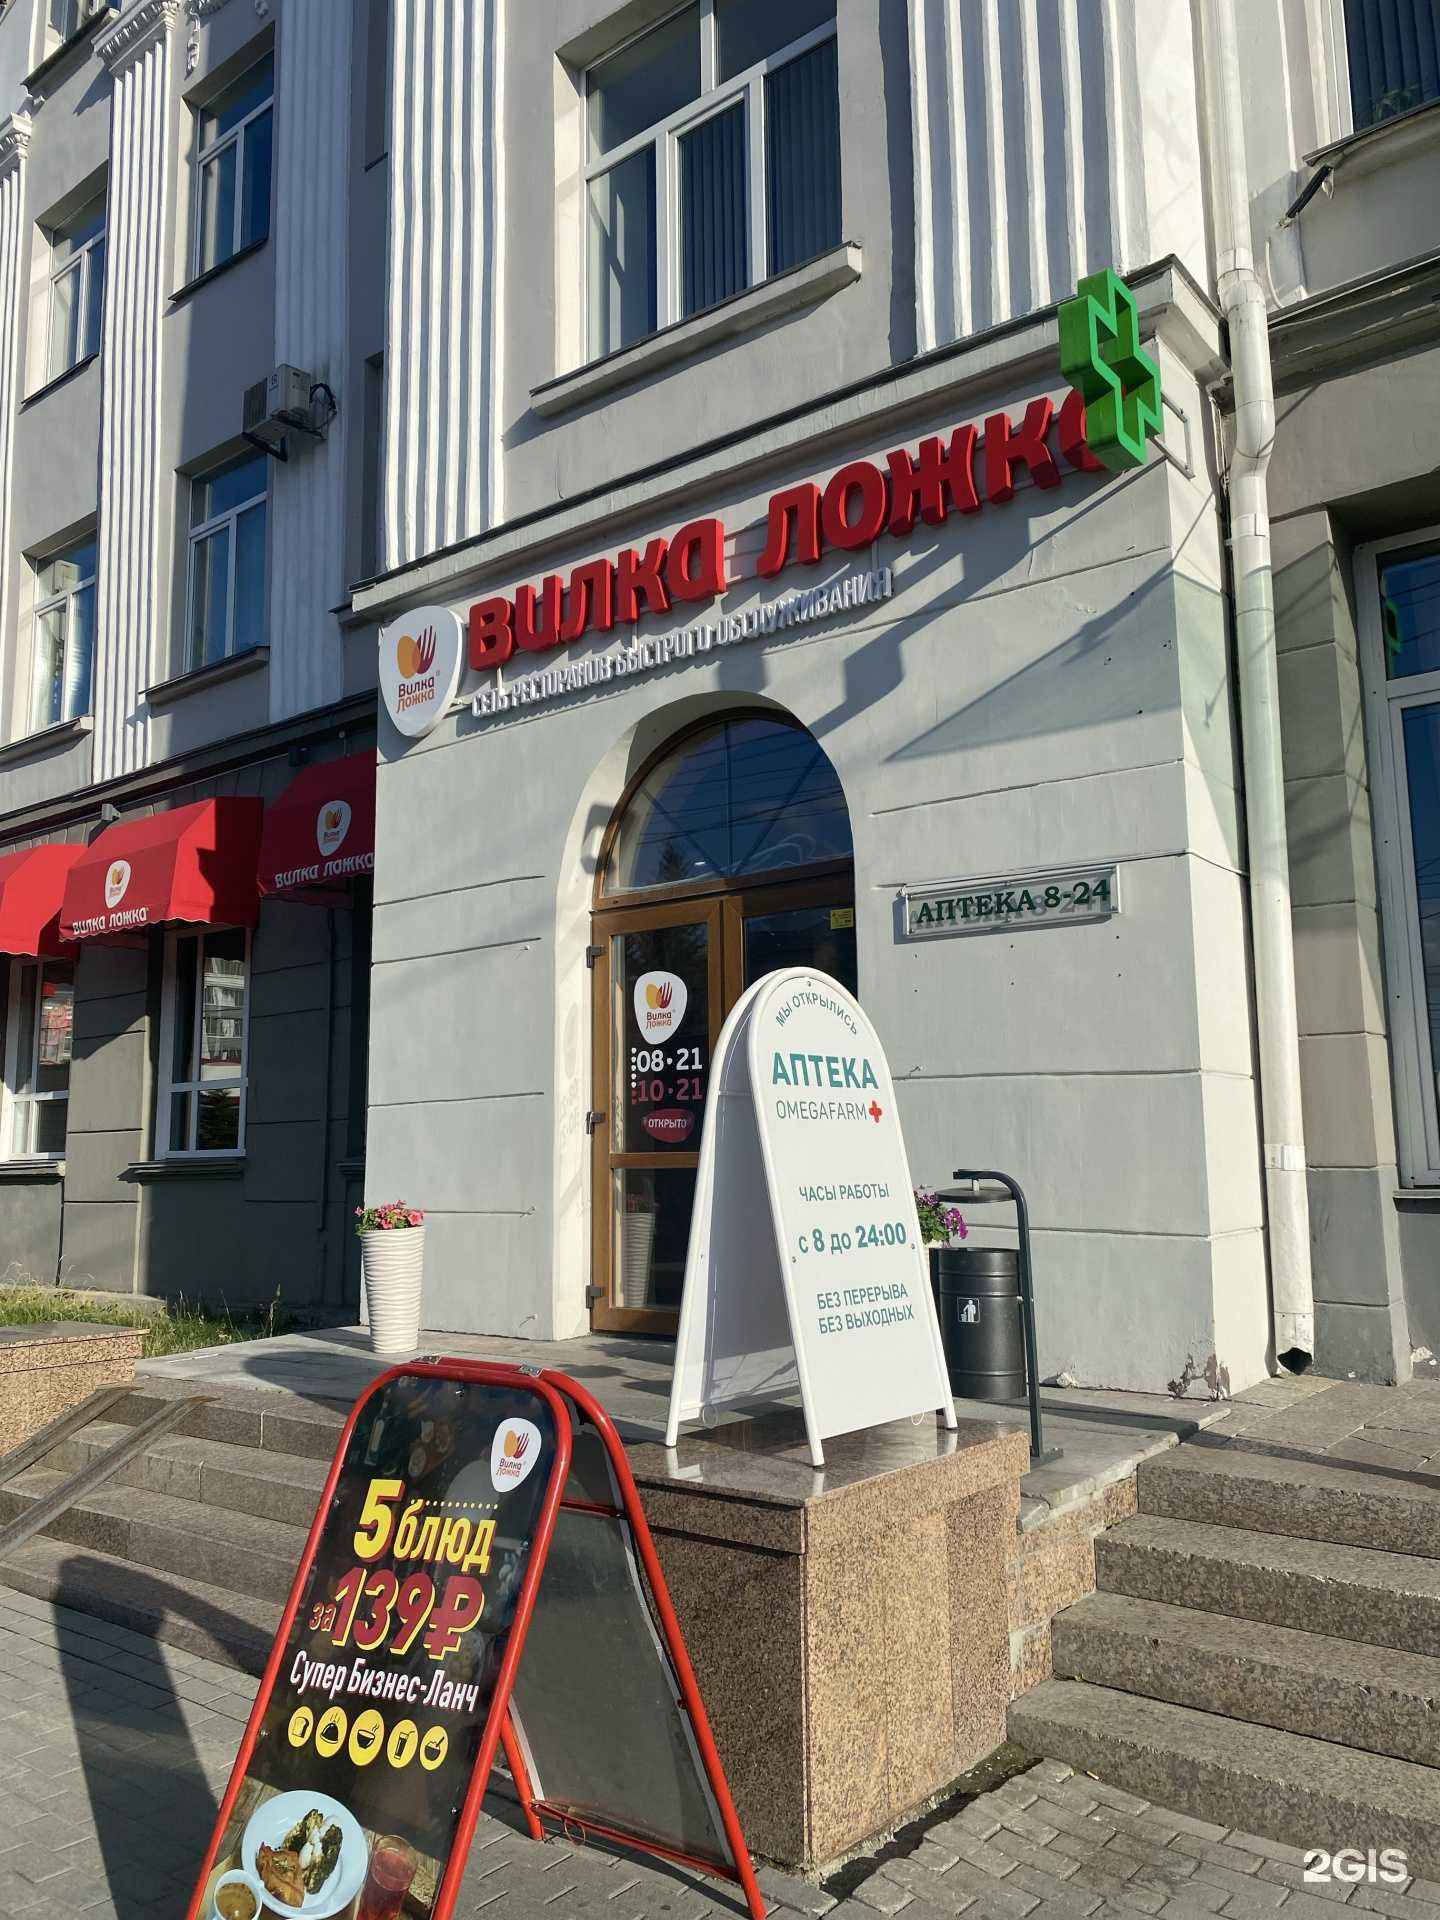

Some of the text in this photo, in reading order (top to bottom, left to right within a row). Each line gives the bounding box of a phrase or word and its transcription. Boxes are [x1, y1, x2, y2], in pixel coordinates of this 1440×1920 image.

[472, 566, 894, 718] СЕТЬ РЕСТОРАНОВ БЫСТРОГО ОБСЛУЖИВАНИЯ
[396, 688, 435, 714] Ложка
[398, 676, 435, 698] Вилка
[917, 879, 1110, 923] АПТЕКА 8-24
[645, 1019, 672, 1030] Ложка
[646, 1011, 672, 1021] Вилка
[776, 992, 857, 1035] МЫ ОТКРЫЛИСЬ
[772, 1052, 879, 1089] АПТЕКА
[648, 1118, 687, 1129] ОТКРЫТО
[776, 1099, 867, 1120] OMEGAFARM
[799, 1183, 889, 1202] ЧАСЫ РАБОТЫ
[812, 1228, 825, 1252] 8
[830, 1232, 852, 1254] до
[855, 1222, 907, 1248] 24:00
[817, 1282, 909, 1310] БЕЗ ПЕРЕРЫВА
[819, 1304, 915, 1334] БЕЗ ВЫХОДНЫХ
[353, 1479, 497, 1576] 5 блюд
[290, 1650, 479, 1712] Супер Бизнес-Ланч
